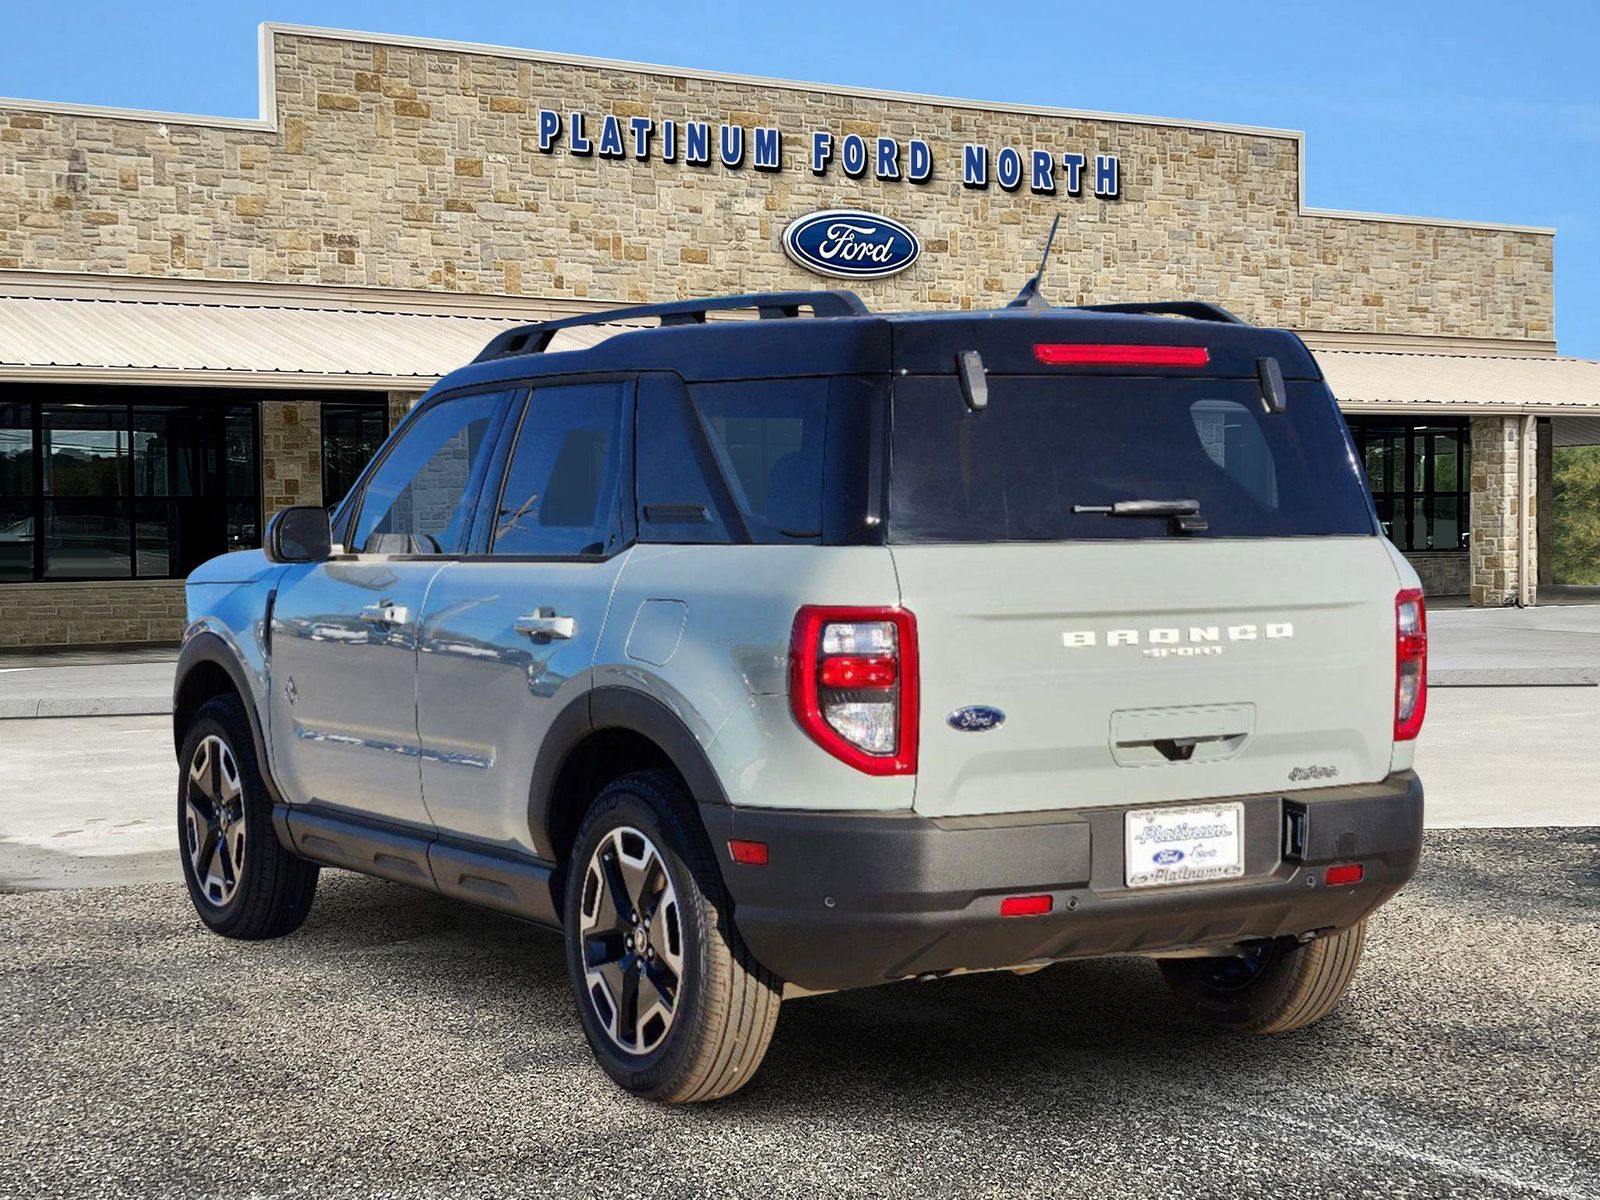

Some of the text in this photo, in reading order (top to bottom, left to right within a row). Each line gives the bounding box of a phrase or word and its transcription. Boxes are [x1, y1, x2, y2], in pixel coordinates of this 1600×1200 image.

[538, 109, 1119, 199] PLATINUM FORD NORTH
[819, 223, 895, 263] Ford
[1061, 622, 1294, 647] BRONCO
[1141, 645, 1223, 658] SPORT
